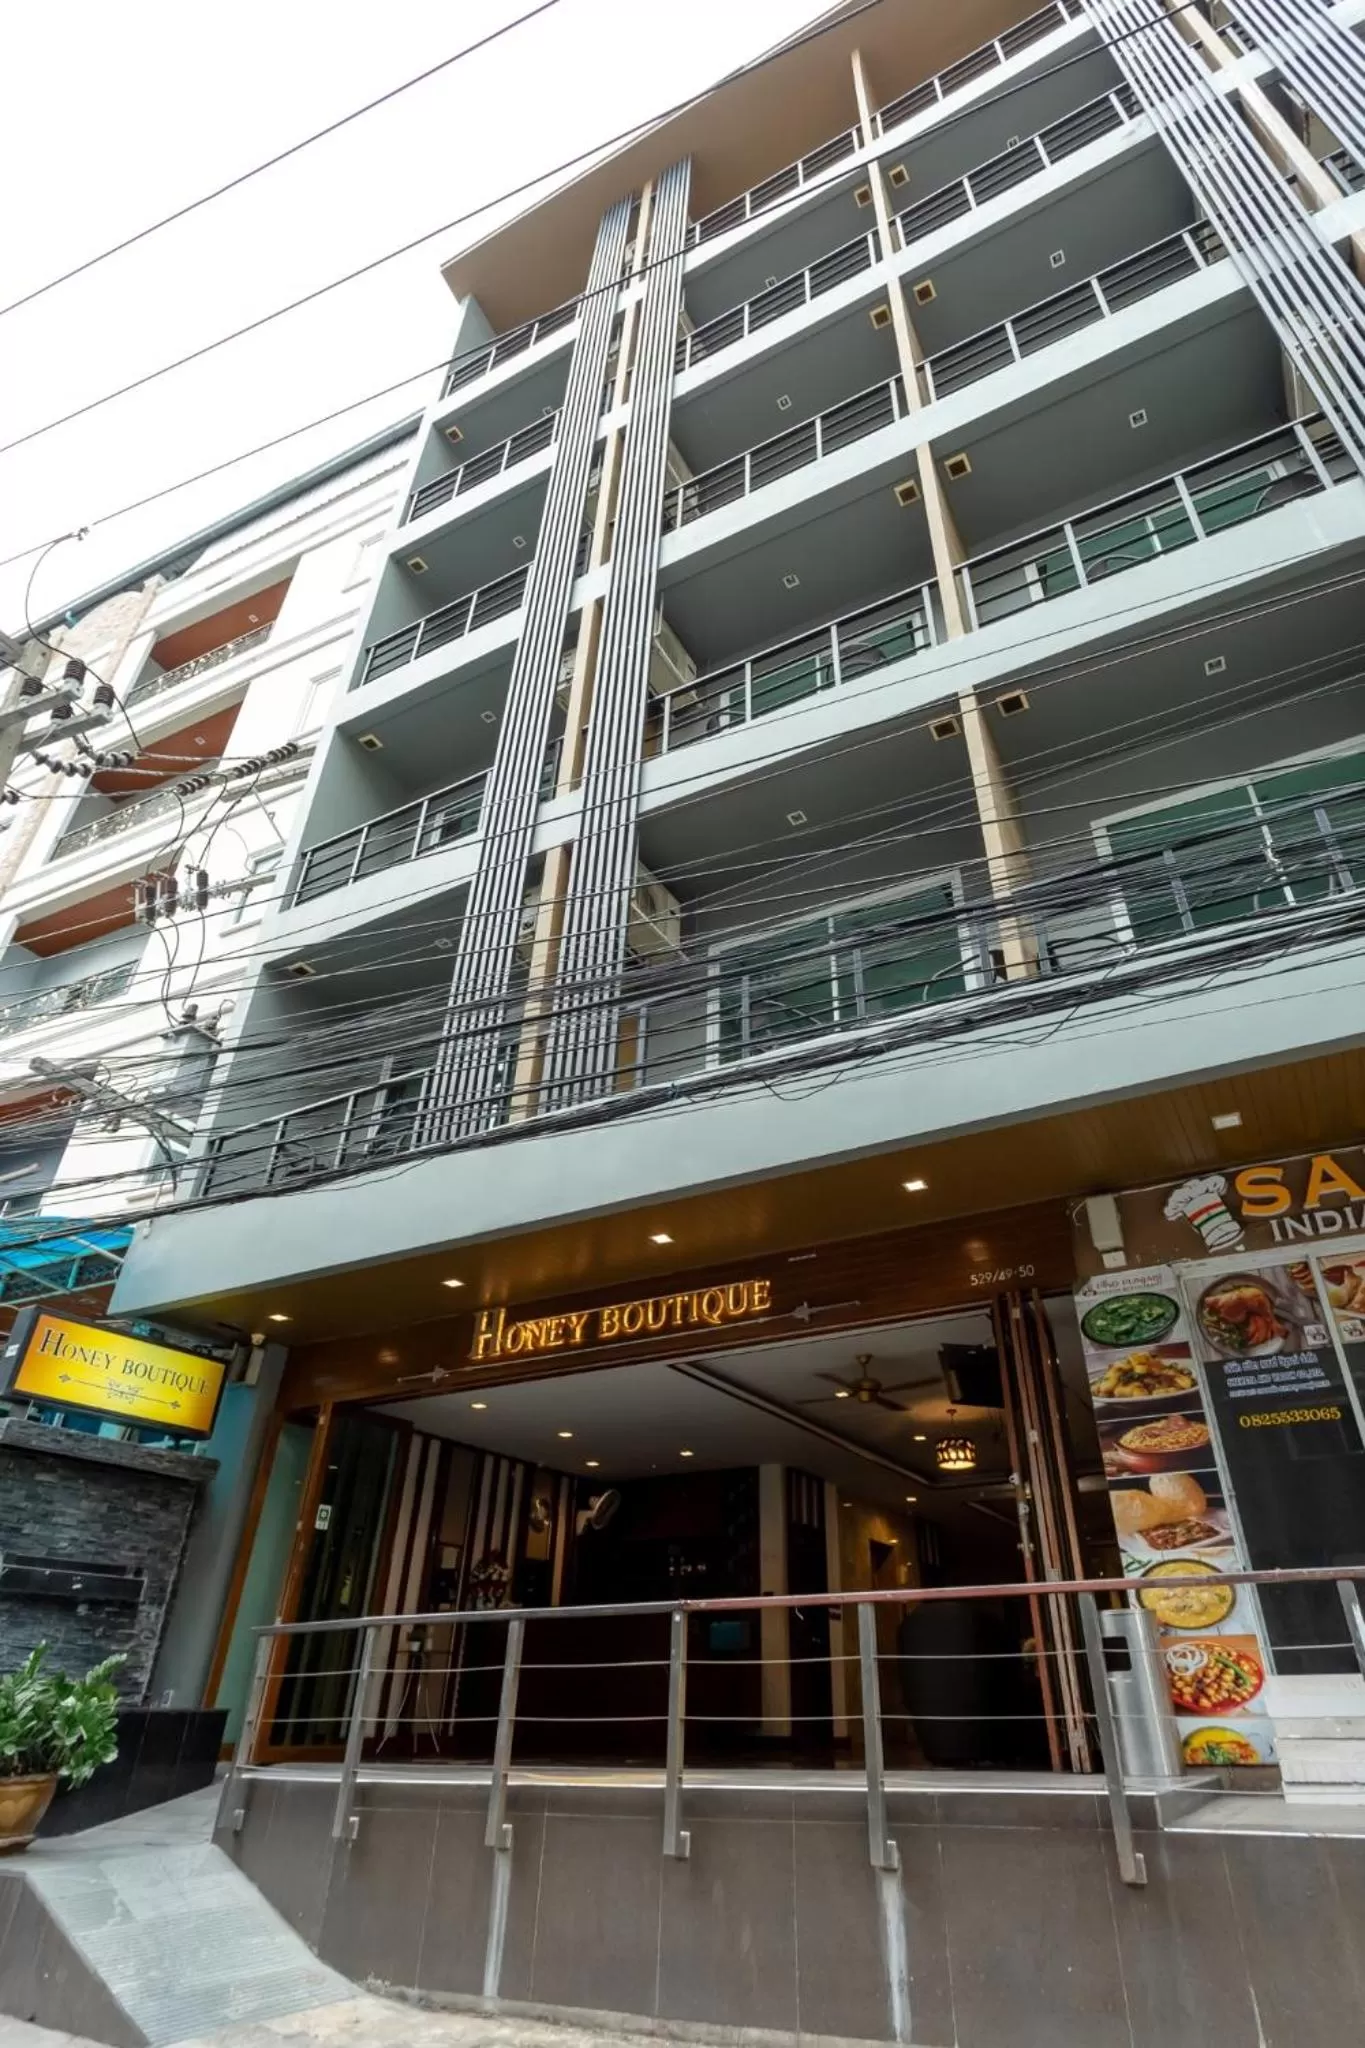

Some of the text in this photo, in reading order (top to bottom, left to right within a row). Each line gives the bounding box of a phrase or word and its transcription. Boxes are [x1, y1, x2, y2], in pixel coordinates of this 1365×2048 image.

[1235, 1154, 1365, 1217] SA
[468, 1279, 772, 1360] HONEY BOUTIQUE
[40, 1328, 209, 1397] HONEY BOUTIQUE
